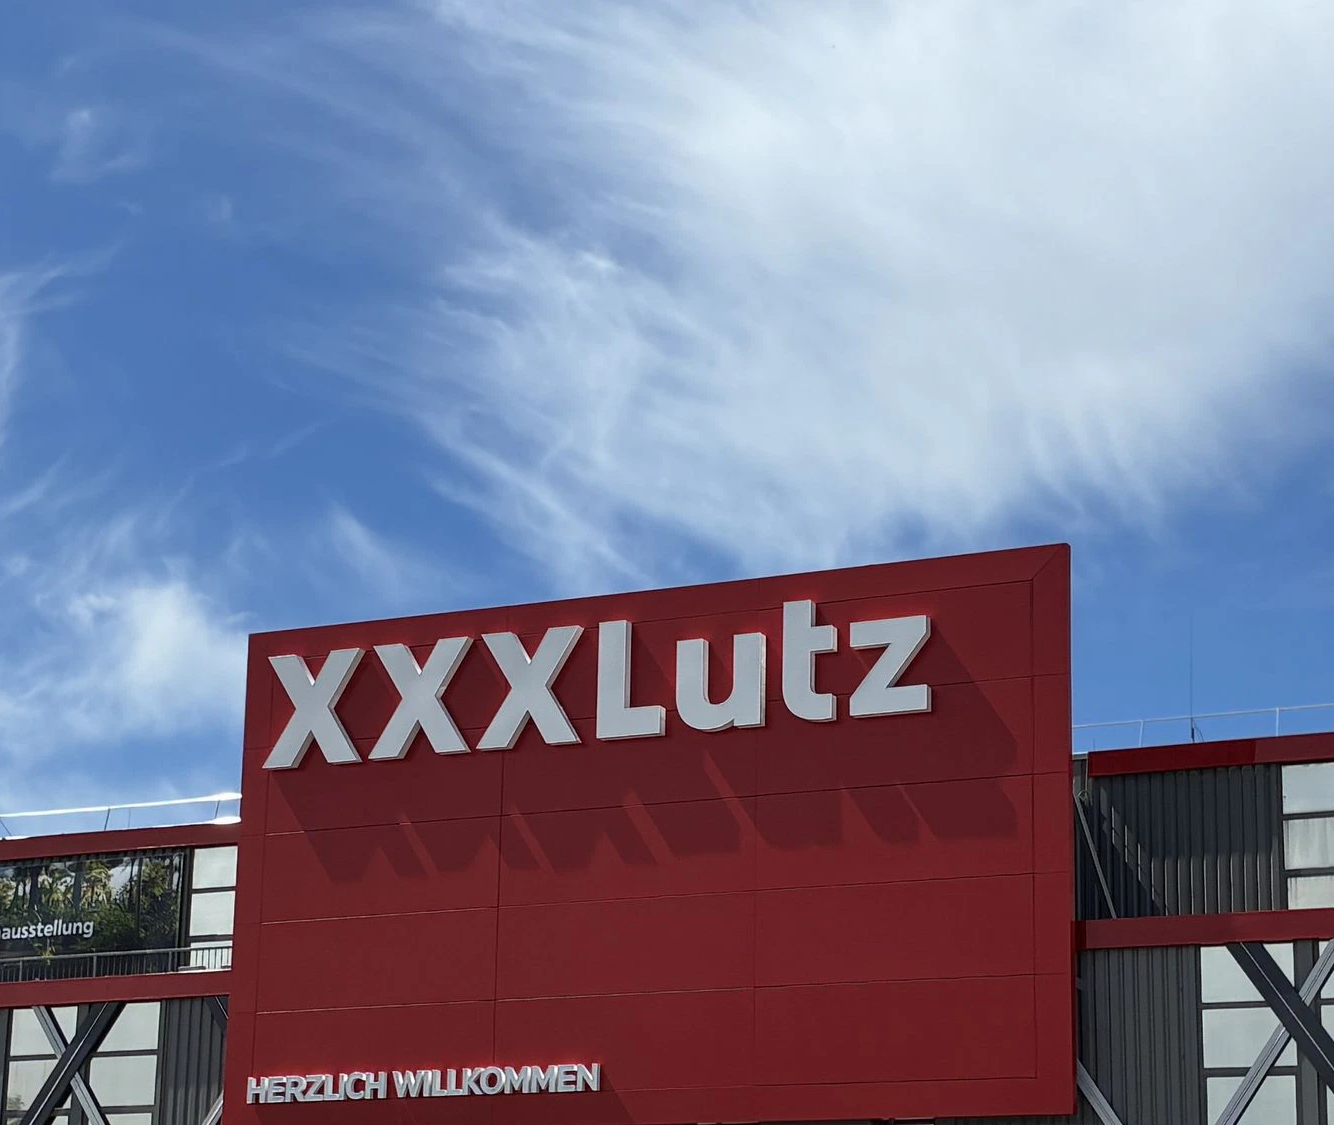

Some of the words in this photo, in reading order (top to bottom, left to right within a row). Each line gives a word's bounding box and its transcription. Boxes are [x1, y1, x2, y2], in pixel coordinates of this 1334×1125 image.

[262, 599, 932, 770] XXXLutz
[246, 1071, 389, 1104] HERZLICH
[392, 1063, 601, 1098] WILLKOMMEN
